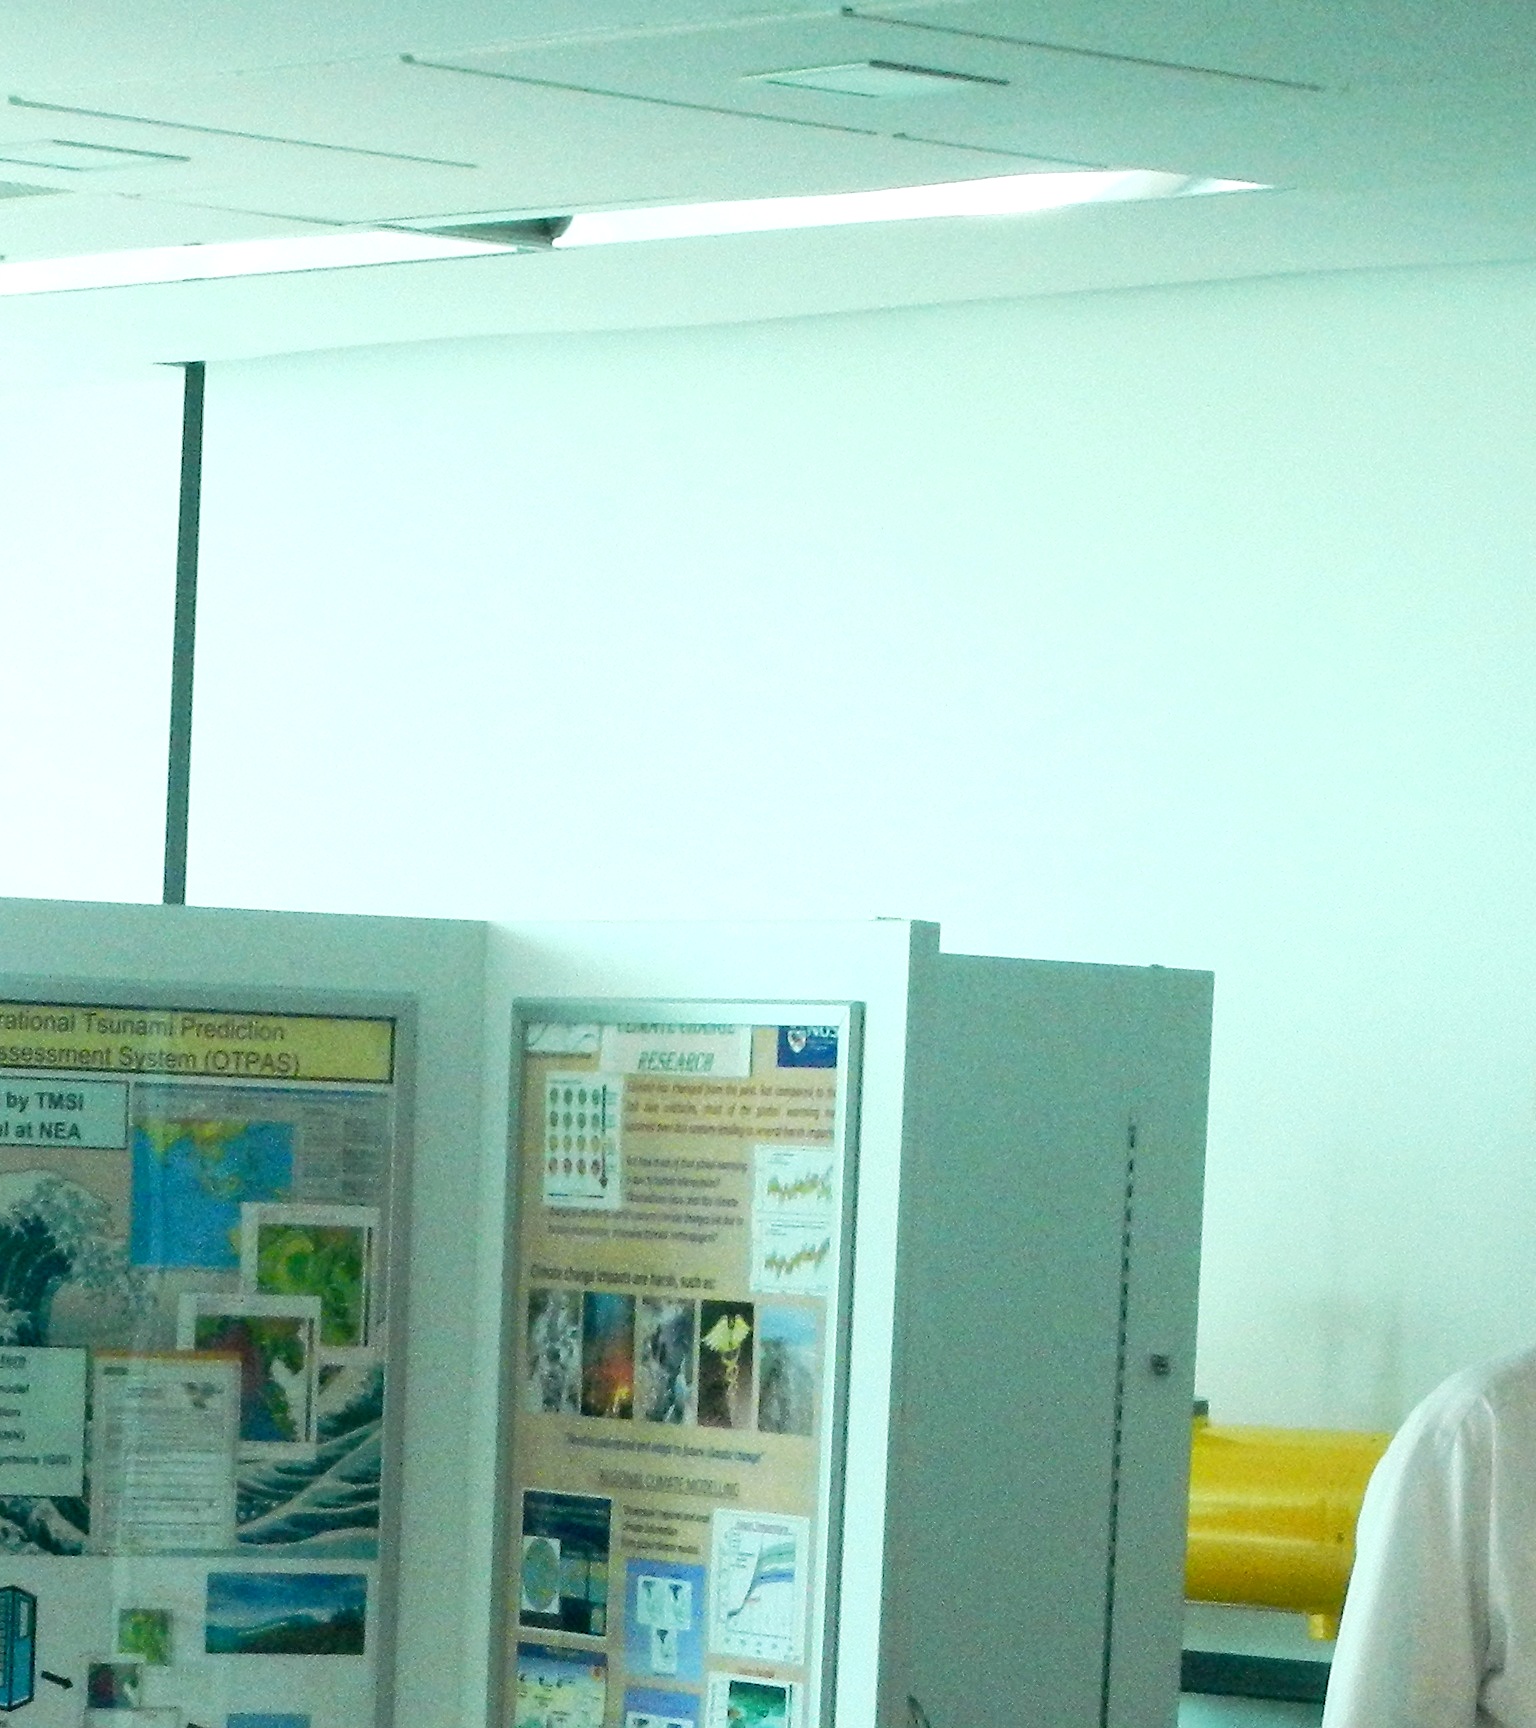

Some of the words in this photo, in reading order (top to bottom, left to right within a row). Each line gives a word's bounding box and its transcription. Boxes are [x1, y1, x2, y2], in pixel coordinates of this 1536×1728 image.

[84, 1013, 174, 1038] Tsunami
[180, 1016, 286, 1042] Prediction
[118, 1046, 197, 1072] System
[203, 1049, 301, 1076] (OTPAS)
[637, 1051, 715, 1072] RESEARCH
[6, 1090, 28, 1112] by
[36, 1092, 84, 1112] TMSI
[15, 1121, 34, 1139] at
[38, 1121, 82, 1140] NEA
